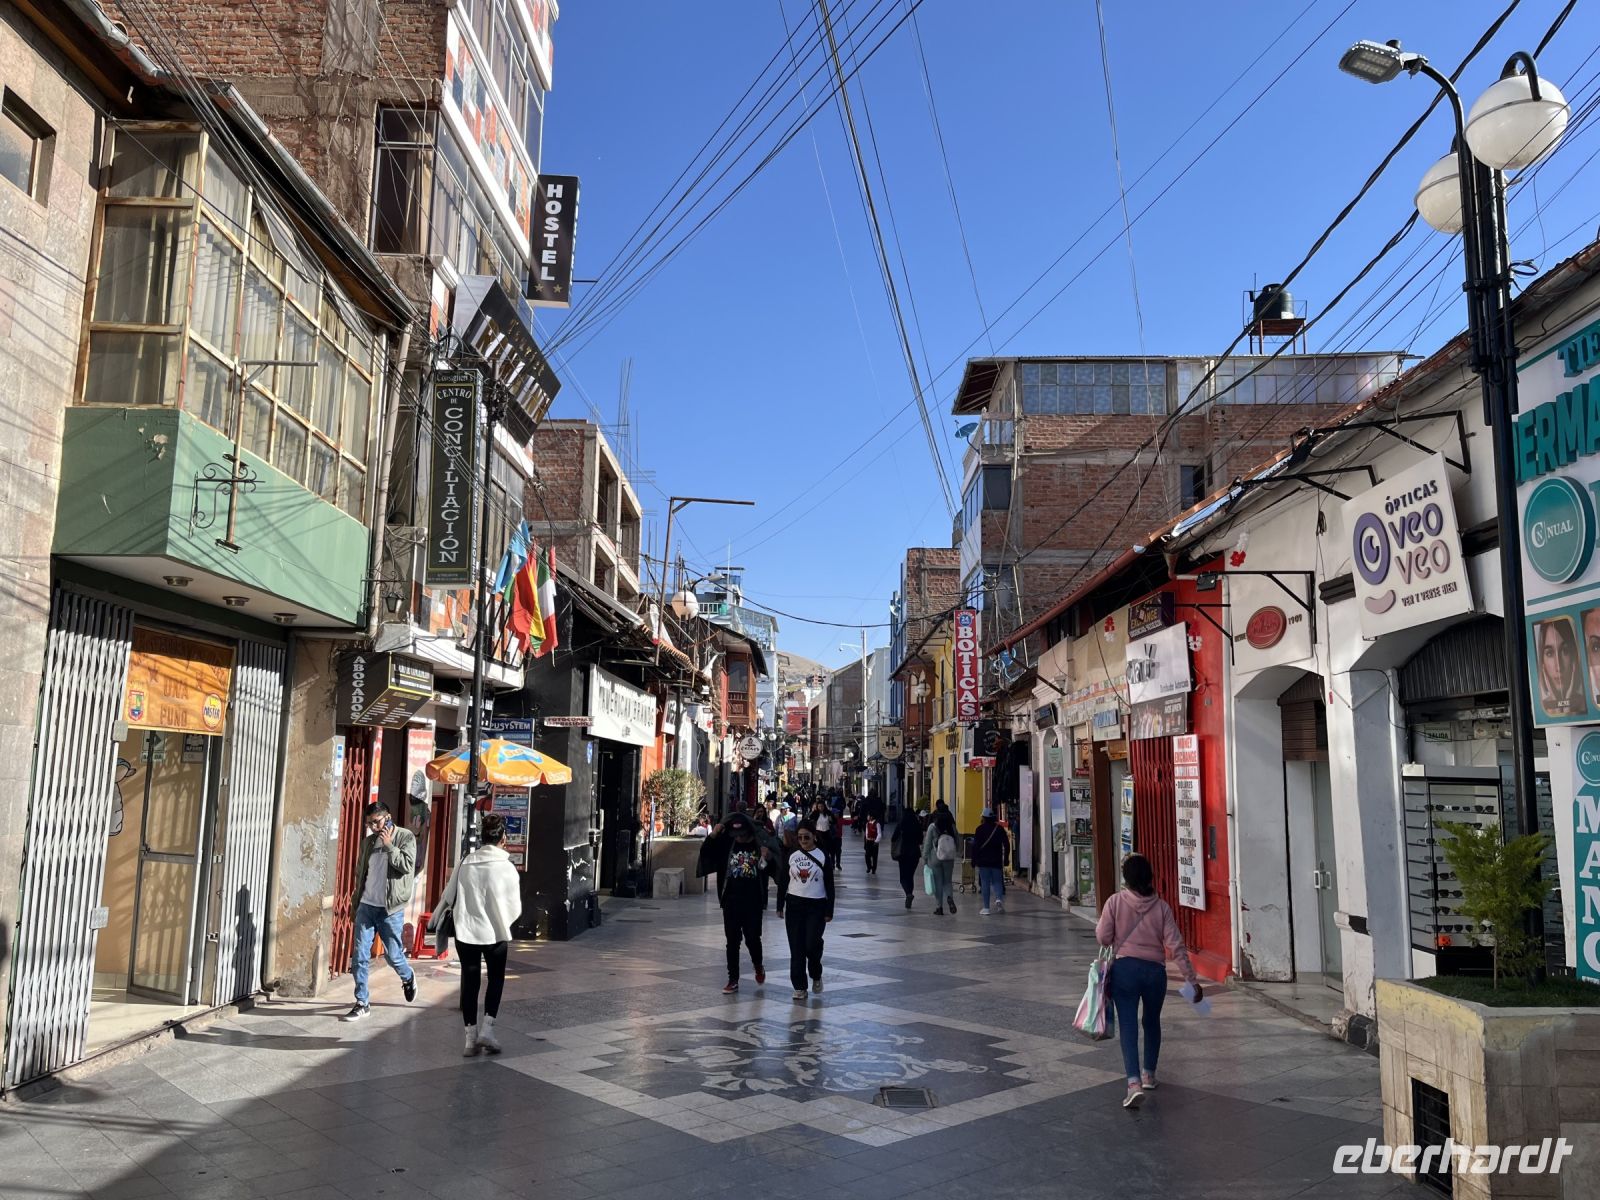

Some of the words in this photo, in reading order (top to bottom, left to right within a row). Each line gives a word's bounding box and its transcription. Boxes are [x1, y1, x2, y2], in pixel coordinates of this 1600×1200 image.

[541, 184, 563, 281] HOSTEL
[436, 387, 472, 399] CENTRO
[438, 407, 463, 563] CONCILIACIÓN
[1385, 480, 1438, 515] ÓPTICAS
[350, 655, 366, 720] ABOGADOS
[957, 626, 977, 716] BOTICAS
[160, 704, 188, 728] PUNO
